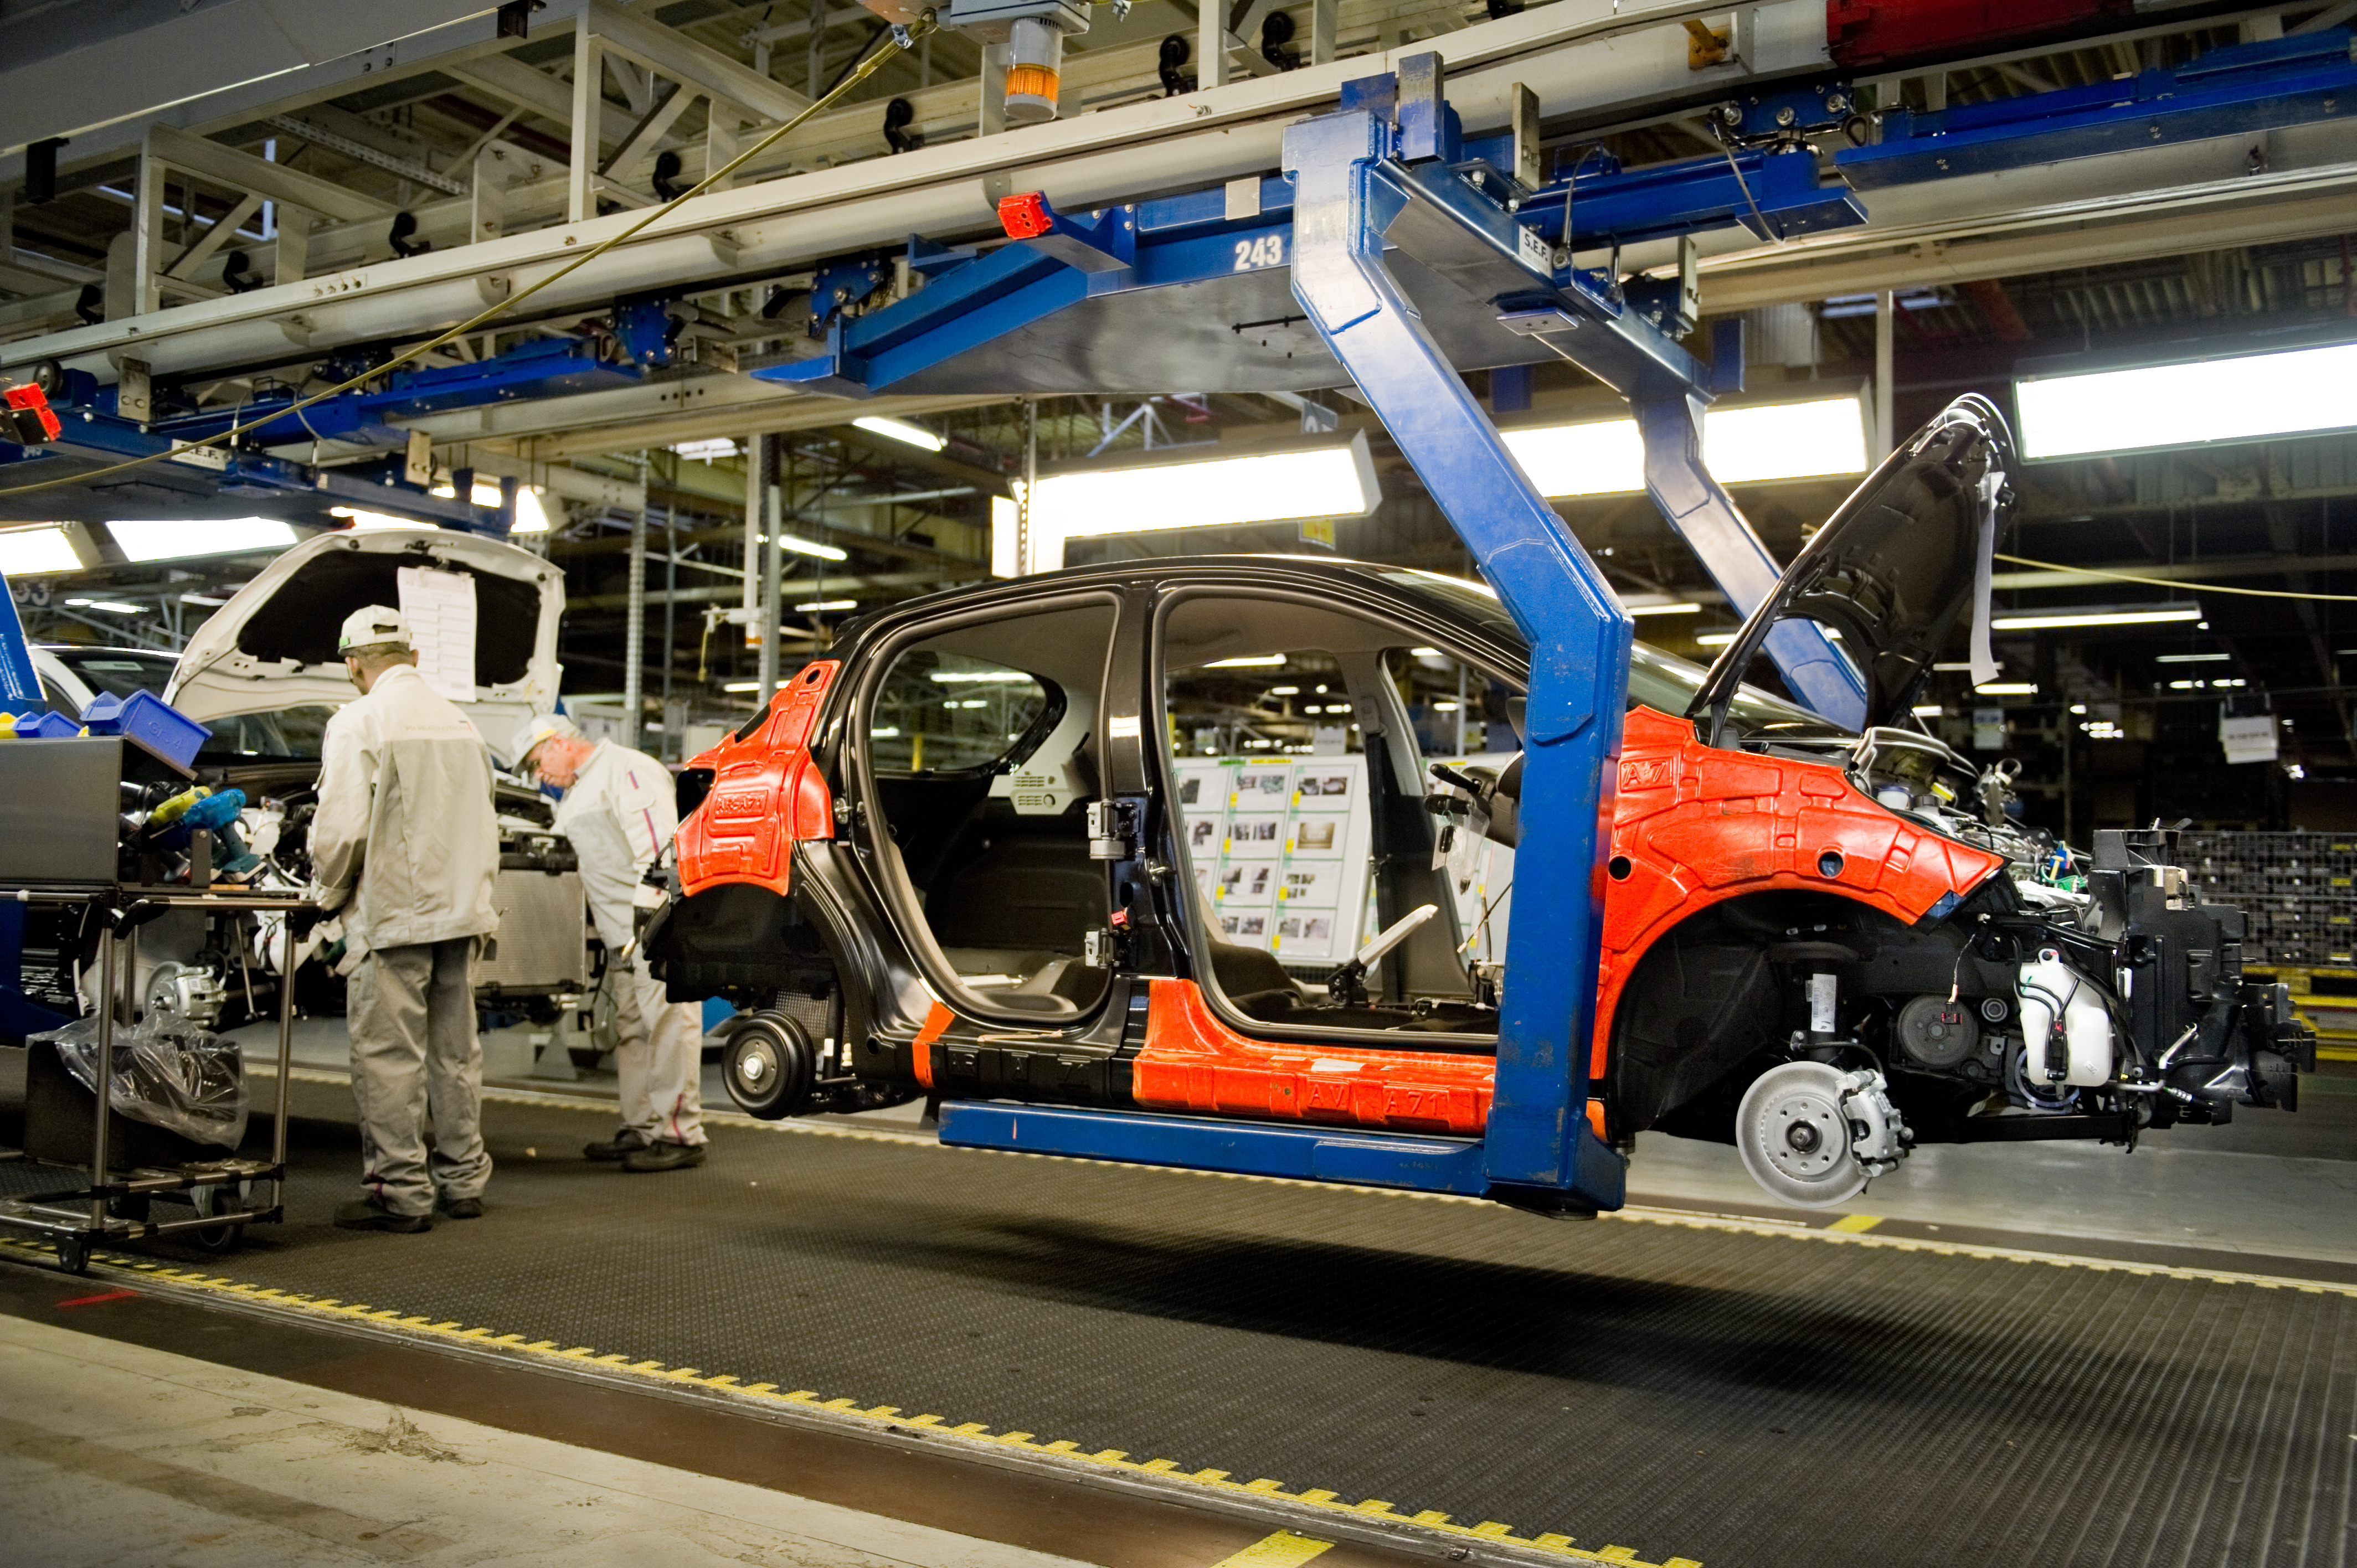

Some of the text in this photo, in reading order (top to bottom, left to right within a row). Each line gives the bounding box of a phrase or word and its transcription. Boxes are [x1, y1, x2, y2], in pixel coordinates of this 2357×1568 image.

[1234, 235, 1283, 271] 243
[1524, 233, 1548, 262] S.E.F.
[1309, 1084, 1345, 1107] AV
